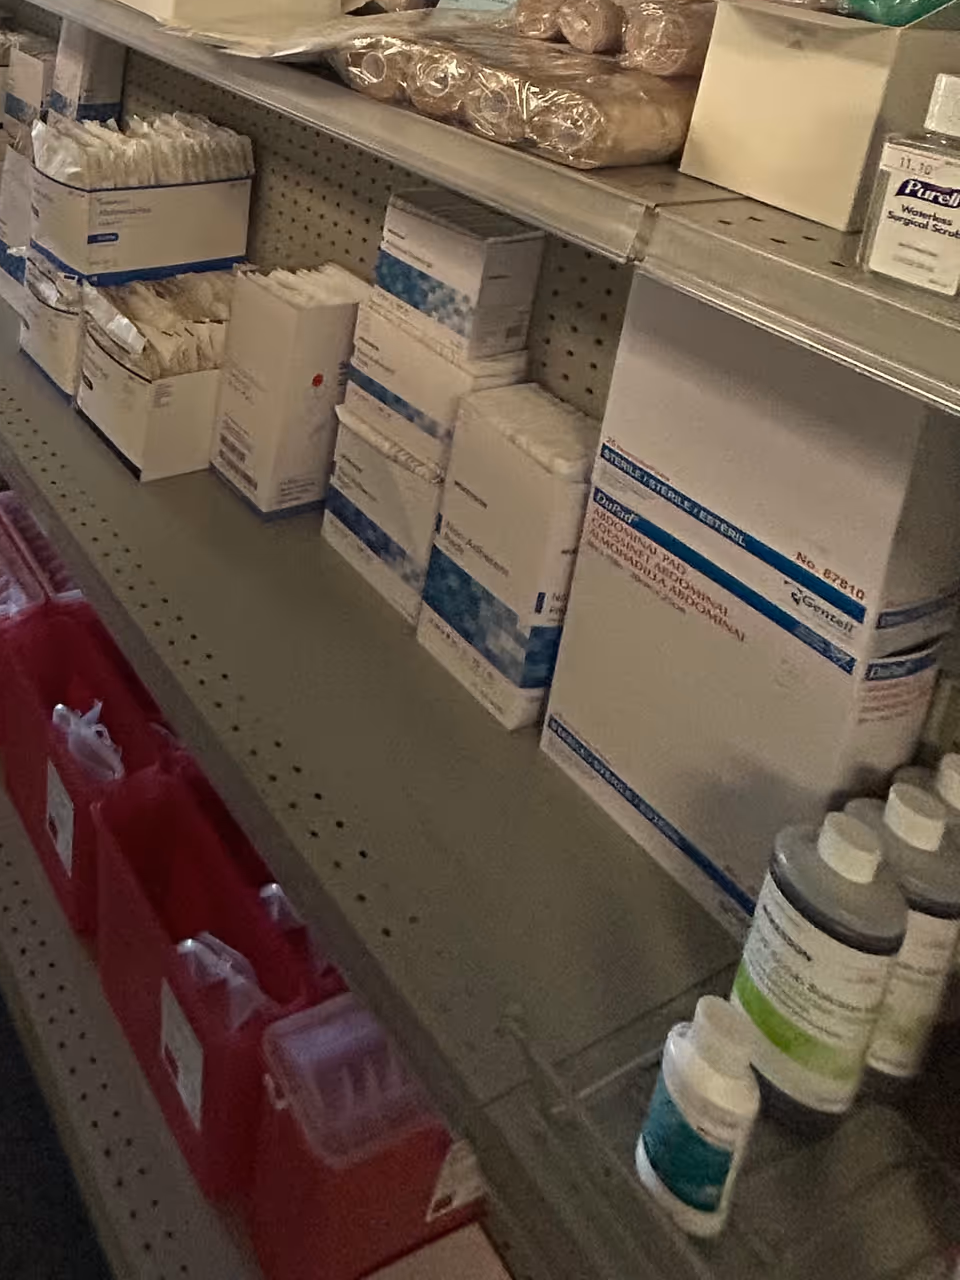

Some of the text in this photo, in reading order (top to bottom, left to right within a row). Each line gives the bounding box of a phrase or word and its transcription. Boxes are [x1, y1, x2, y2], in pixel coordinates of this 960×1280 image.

[904, 179, 960, 208] Purell
[887, 210, 929, 231] Surgical
[901, 203, 953, 226] Waterless
[603, 448, 642, 480] STERILE
[593, 507, 688, 576] ABDOMINAL PAD
[654, 562, 729, 618] ABDOMINAL
[669, 585, 746, 642] ABDOMINAL
